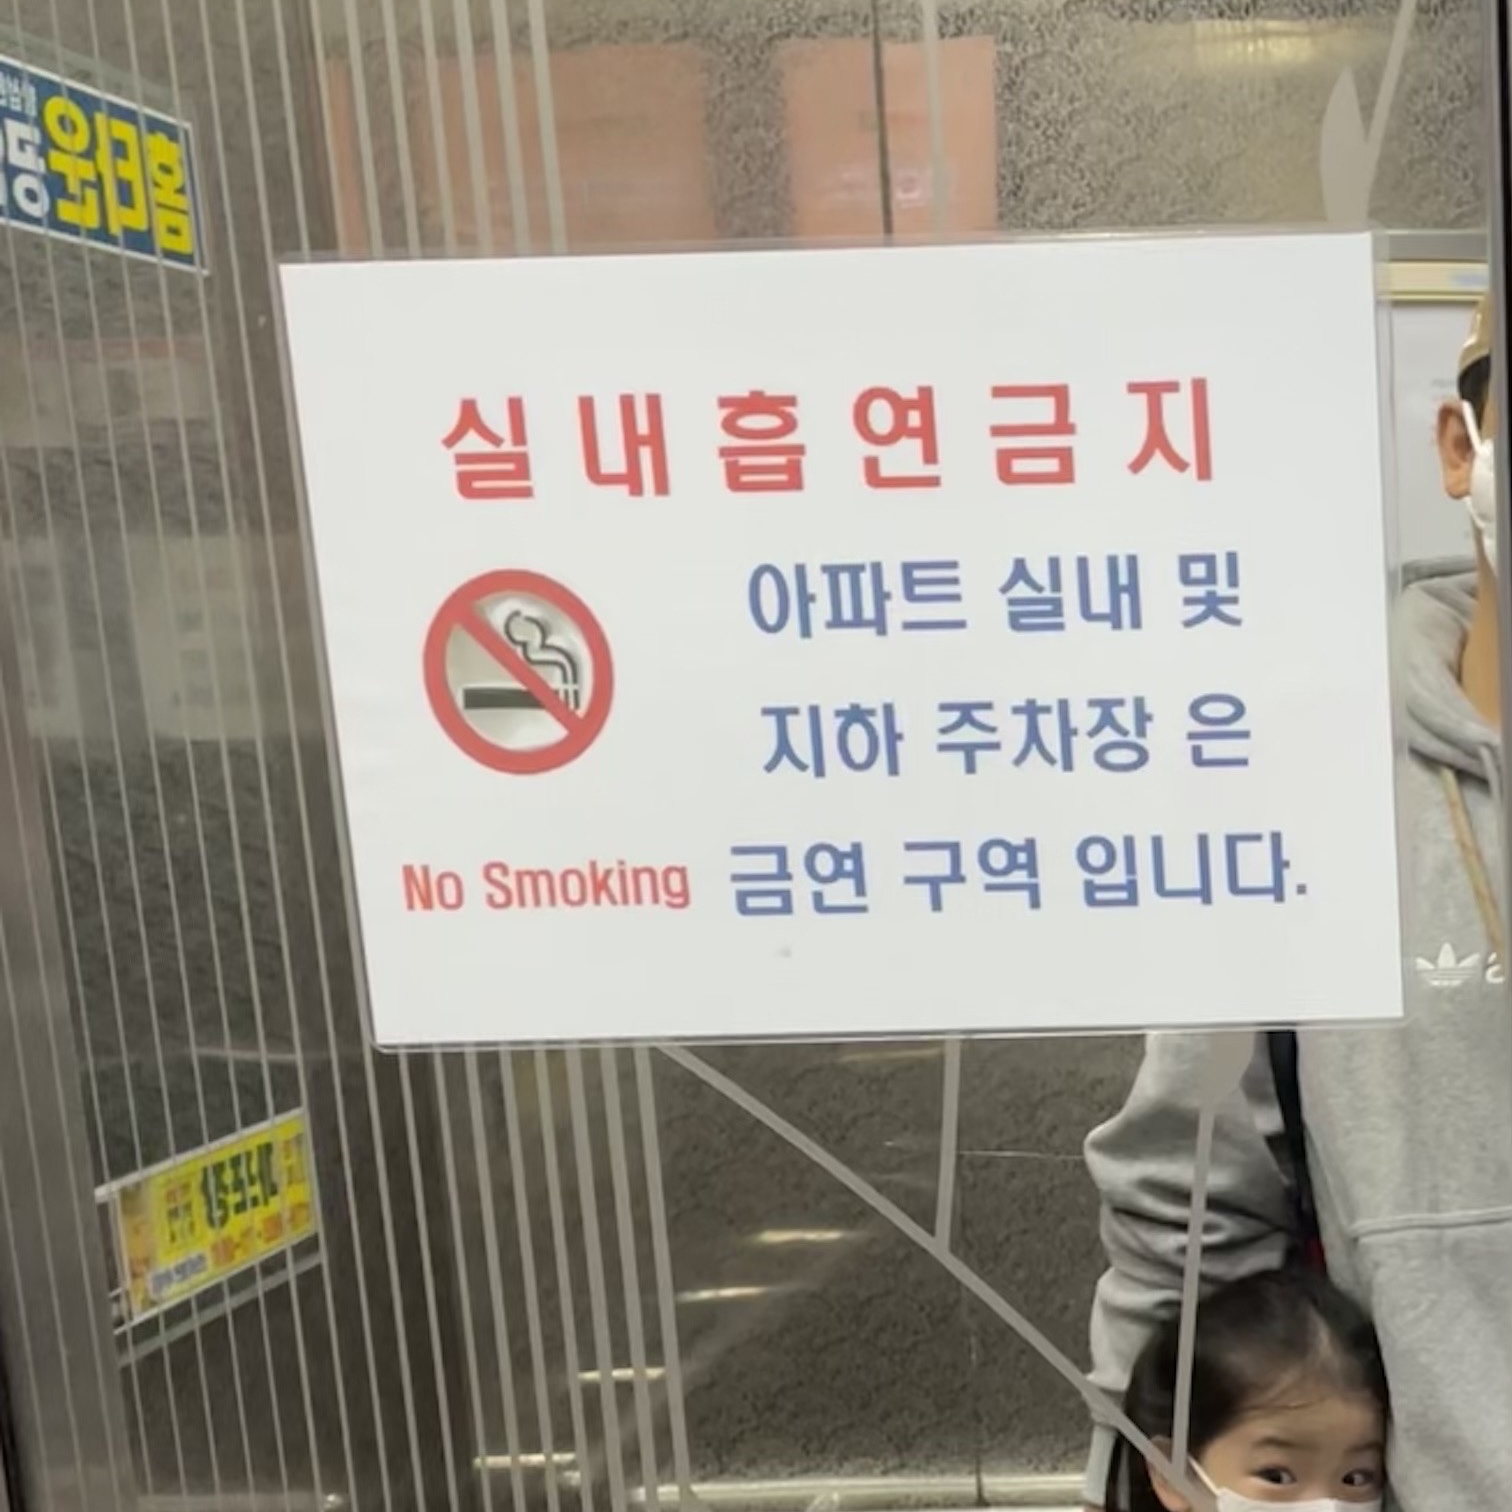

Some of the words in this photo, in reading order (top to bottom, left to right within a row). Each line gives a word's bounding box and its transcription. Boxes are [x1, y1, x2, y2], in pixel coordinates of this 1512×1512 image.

[748, 560, 968, 640] 아파트
[998, 553, 1143, 633] 실내
[1178, 550, 1243, 629] 및
[760, 702, 905, 779] 지하
[936, 696, 1154, 775] 주차장
[1186, 693, 1251, 768] 은
[402, 864, 464, 911] No
[482, 859, 691, 910] Smoking
[730, 841, 869, 917] 금연
[903, 837, 1042, 913] 구역
[1075, 831, 1307, 908] 입니다.
